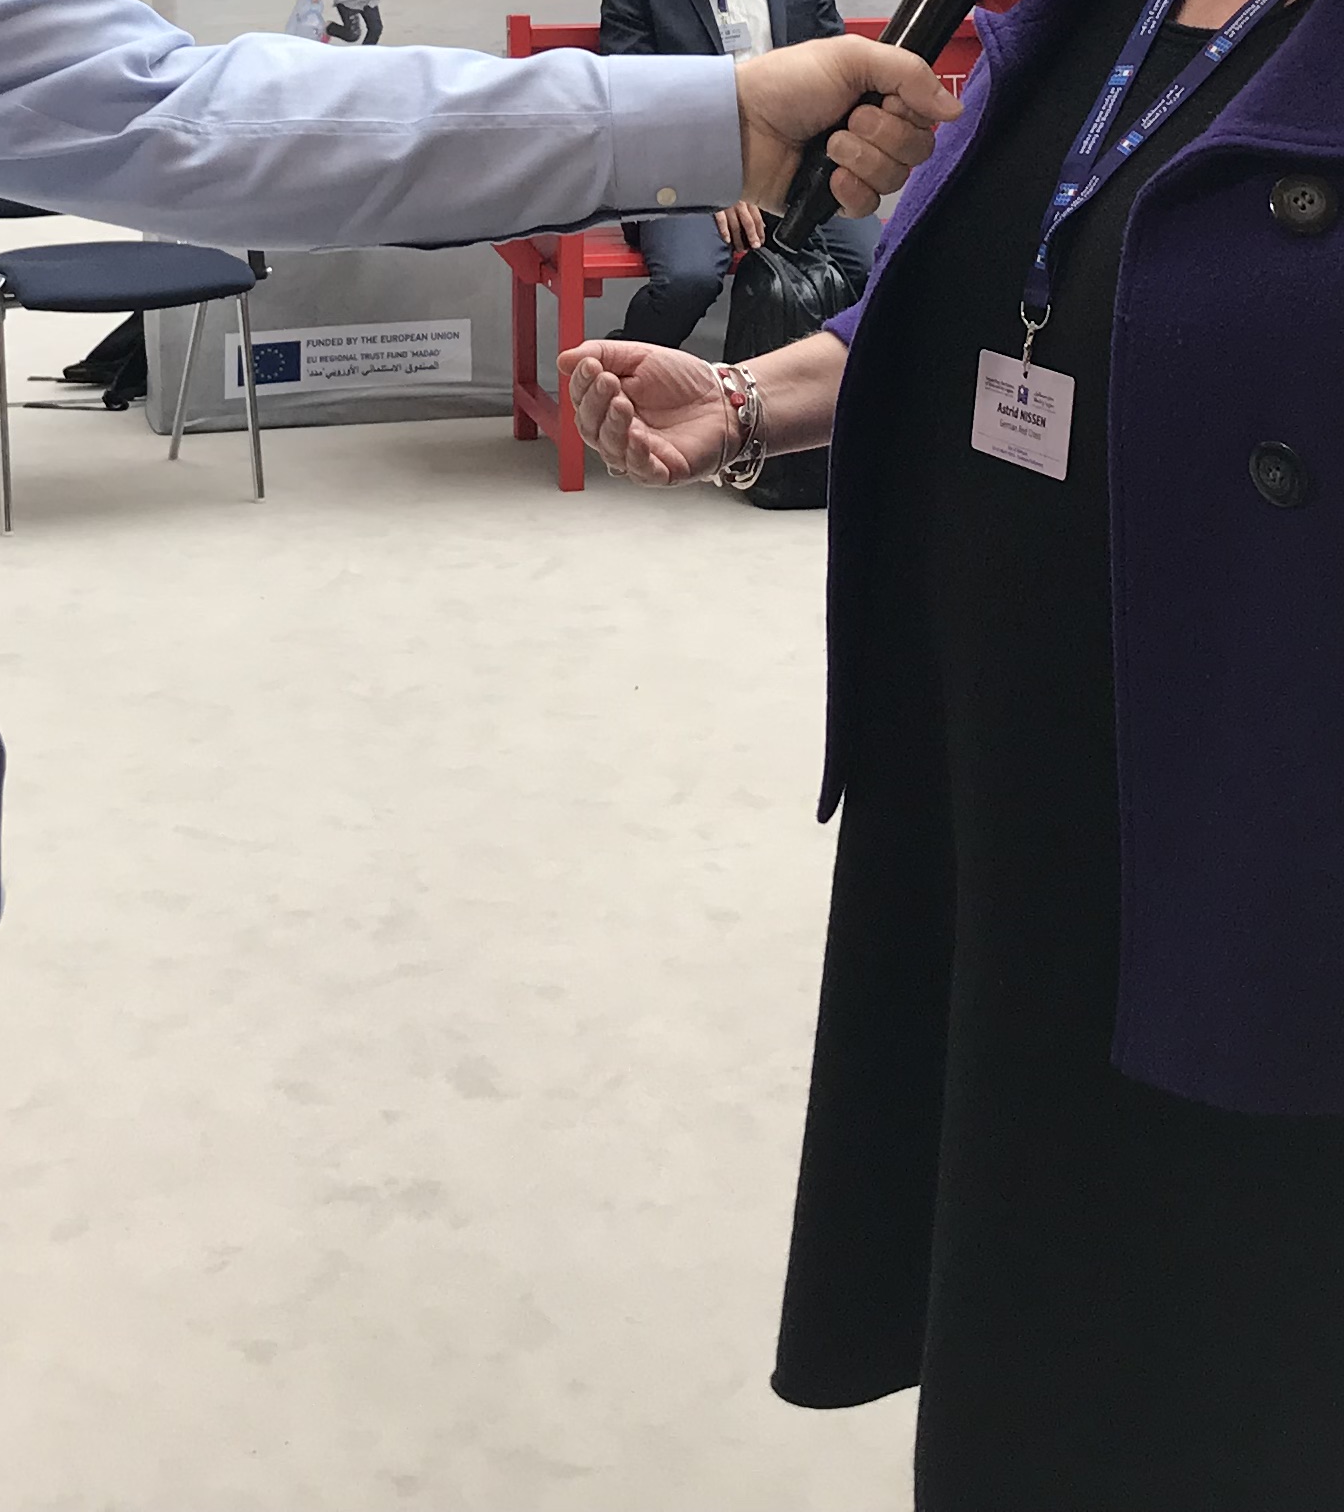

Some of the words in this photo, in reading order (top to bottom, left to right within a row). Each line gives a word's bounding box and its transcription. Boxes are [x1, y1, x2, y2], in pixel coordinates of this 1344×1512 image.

[1095, 121, 1104, 133] the
[306, 338, 343, 348] FUNDED
[346, 337, 358, 346] BY
[361, 336, 377, 344] THE
[380, 333, 428, 344] EUROPEAN
[431, 331, 460, 341] UNION
[319, 354, 357, 363] REGIONAL
[360, 352, 384, 360] TRUST
[386, 351, 407, 360] FUND
[997, 402, 1019, 419] Astrid
[1020, 409, 1046, 428] NISSEN
